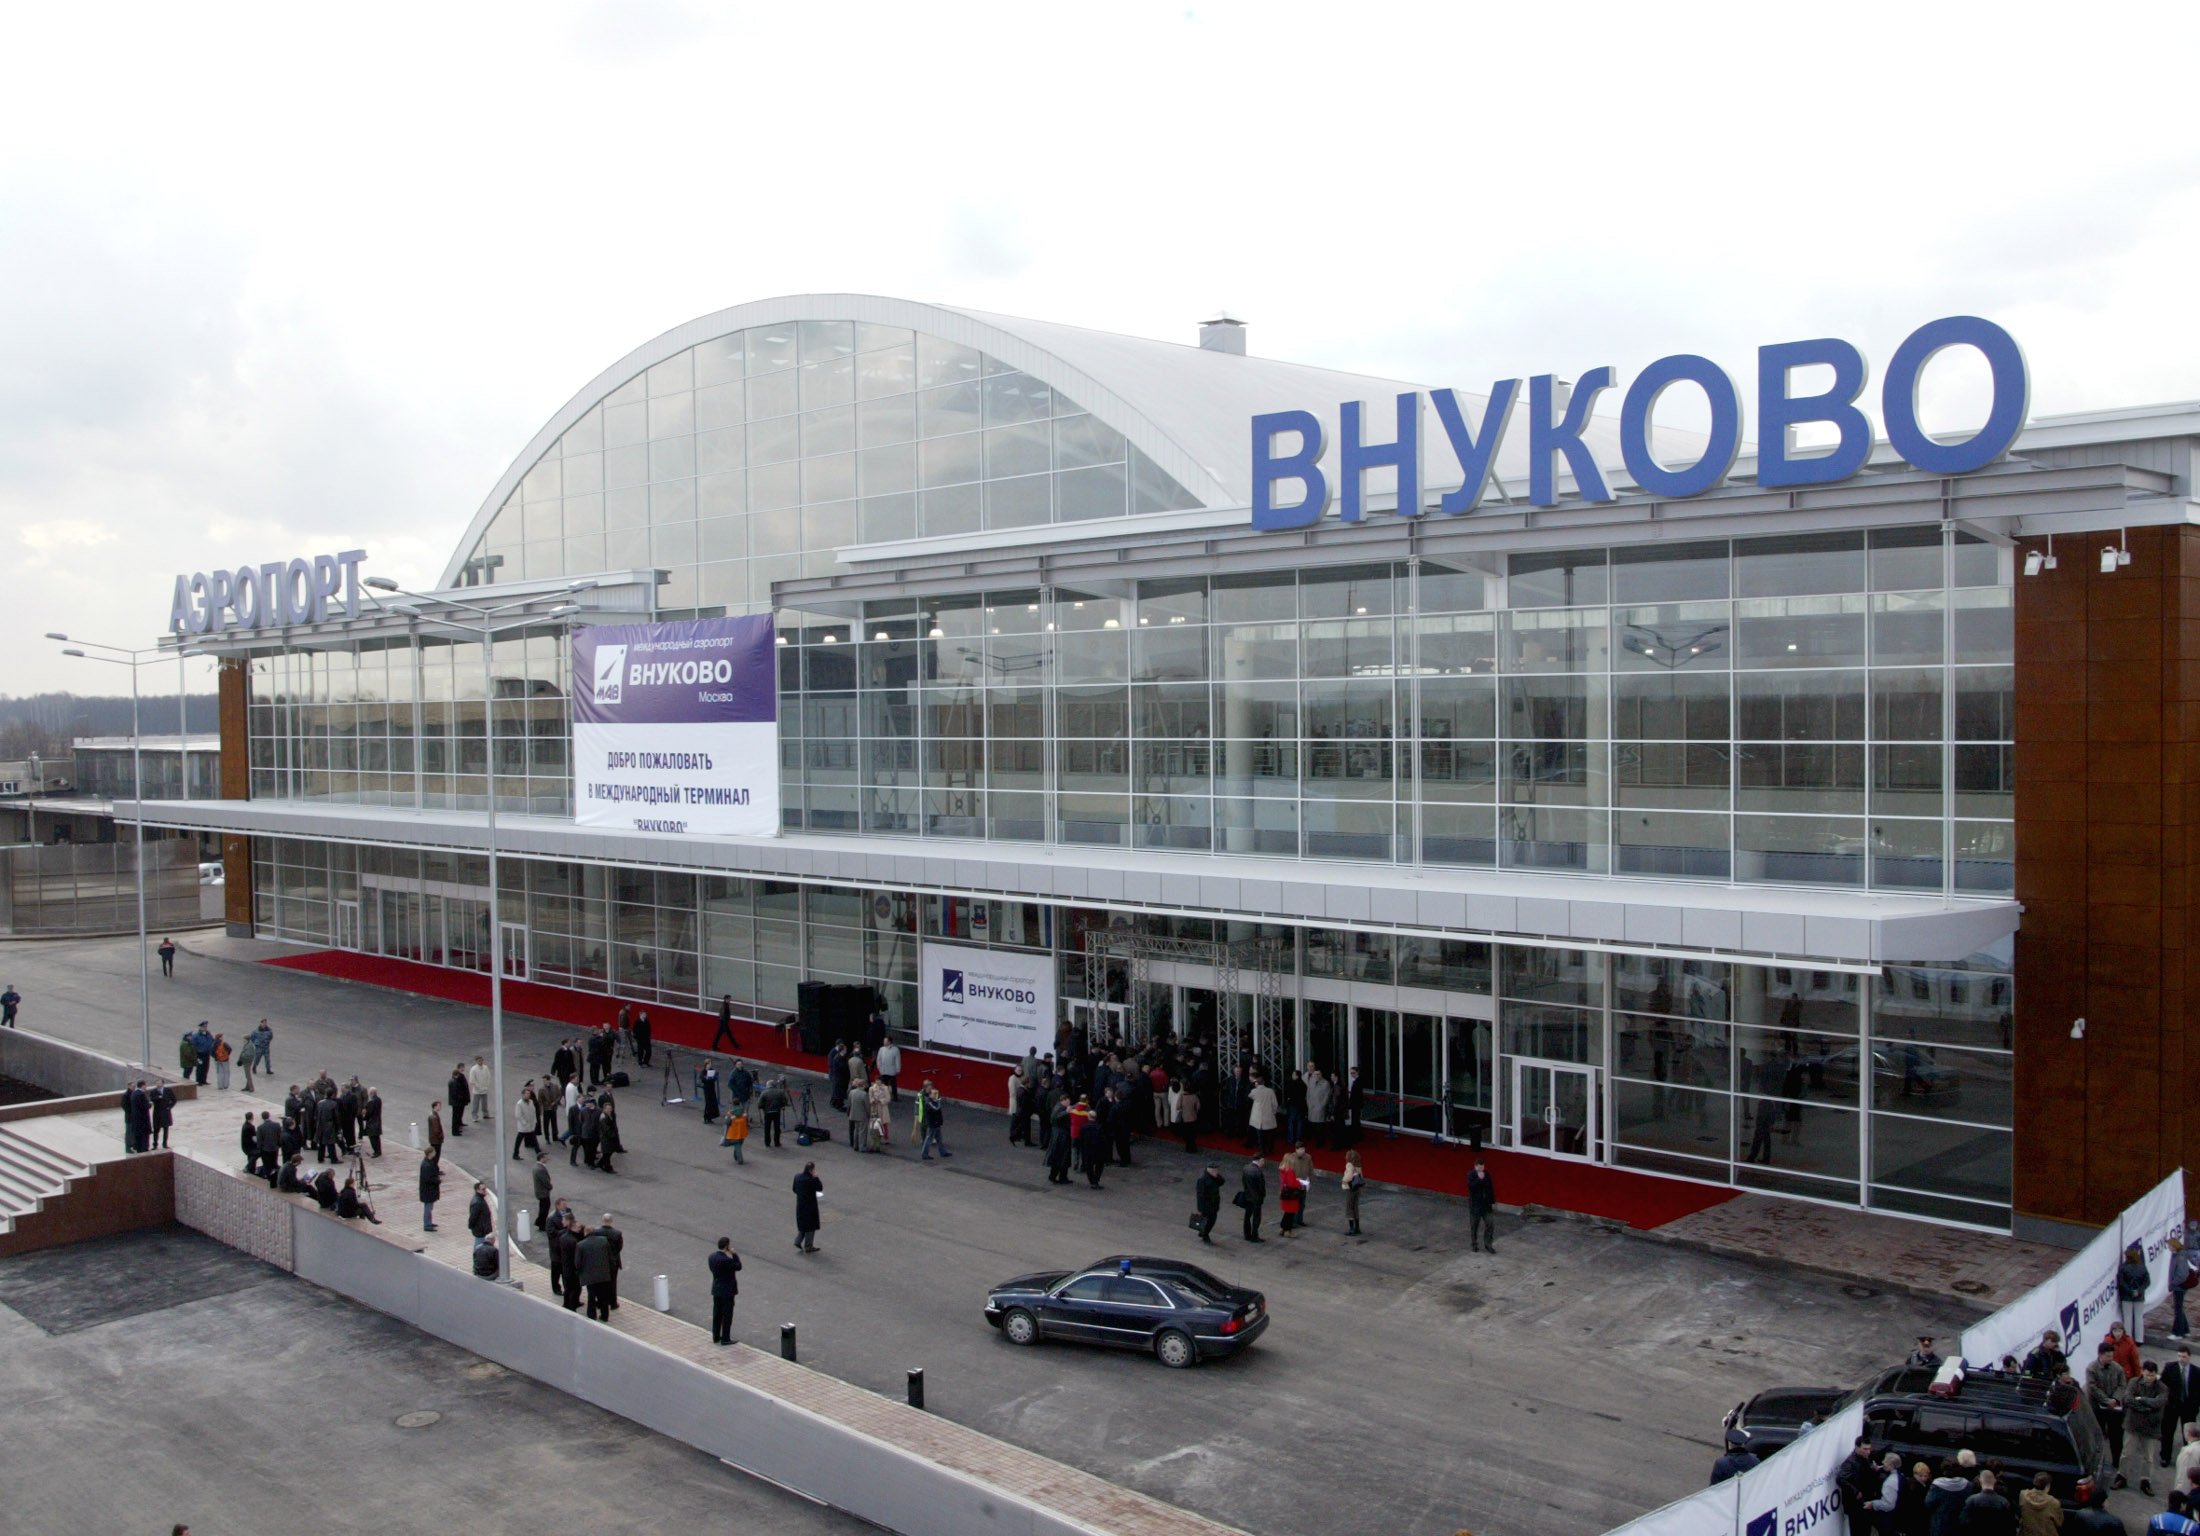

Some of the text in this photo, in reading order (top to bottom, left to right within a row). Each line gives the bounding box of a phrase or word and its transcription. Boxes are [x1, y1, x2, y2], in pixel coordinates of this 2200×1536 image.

[1252, 315, 2031, 532] ВНУКОВО
[169, 549, 368, 633] АЭРОПОРТ
[694, 636, 734, 650] аэропорт
[629, 659, 733, 686] ВНУКОВО
[698, 691, 734, 703] Москва
[607, 751, 713, 770] ДОБРО ПОЖАЛОВАТЬ
[588, 783, 750, 806] В МЕЖДУНАРОДНЫЙ ТЕРМИНАЛ
[968, 983, 1036, 1005] ВНУКОВО
[1784, 1488, 1841, 1536] ВНУКО
